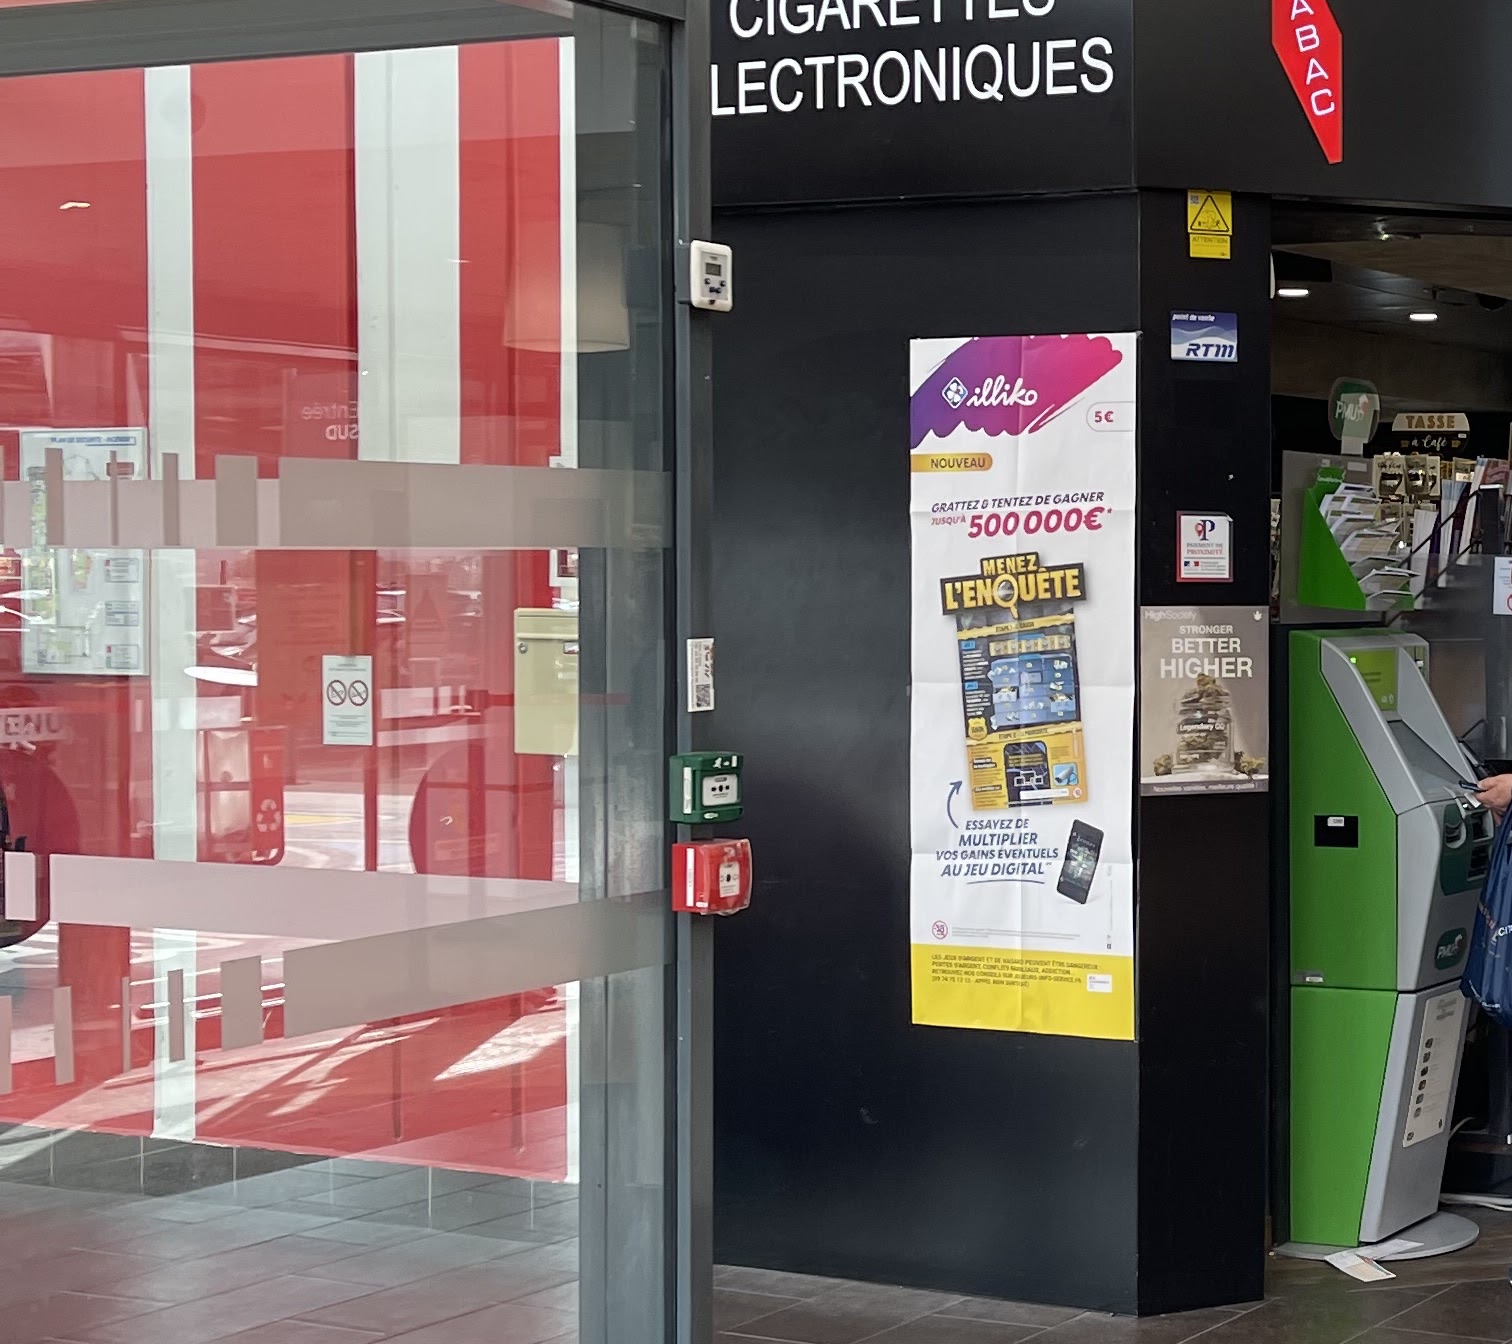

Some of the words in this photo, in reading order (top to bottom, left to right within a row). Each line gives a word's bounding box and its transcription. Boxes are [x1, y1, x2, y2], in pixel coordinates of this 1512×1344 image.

[710, 36, 1114, 117] LECTRONIQUES
[1186, 343, 1235, 357] RTM
[966, 375, 1038, 407] illiko
[1094, 411, 1114, 423] 5€
[1405, 415, 1456, 429] TASSE
[1422, 434, 1448, 451] Café
[930, 457, 986, 469] NOUVEAU
[931, 499, 979, 513] GRATTEZ
[981, 500, 989, 510] &
[991, 496, 1033, 509] TENTEZ
[1035, 494, 1051, 505] DE
[1053, 492, 1105, 505] GAGNER
[967, 511, 1020, 538] 500
[982, 555, 1037, 576] MENEZ
[944, 567, 1082, 619] L'ENQUÊTE
[1179, 624, 1234, 634] STRONGER
[1171, 637, 1241, 654] BETTER
[1160, 657, 1253, 678] HIGHER
[965, 819, 1012, 831] ESSAYEZ
[1015, 818, 1029, 829] DE
[958, 832, 1038, 847] MULTIPLIER
[936, 850, 958, 861] VOS
[960, 849, 996, 861] GAINS
[997, 846, 1059, 860] ÉVENTUELS
[941, 864, 962, 877] AU
[963, 863, 989, 876] JEU
